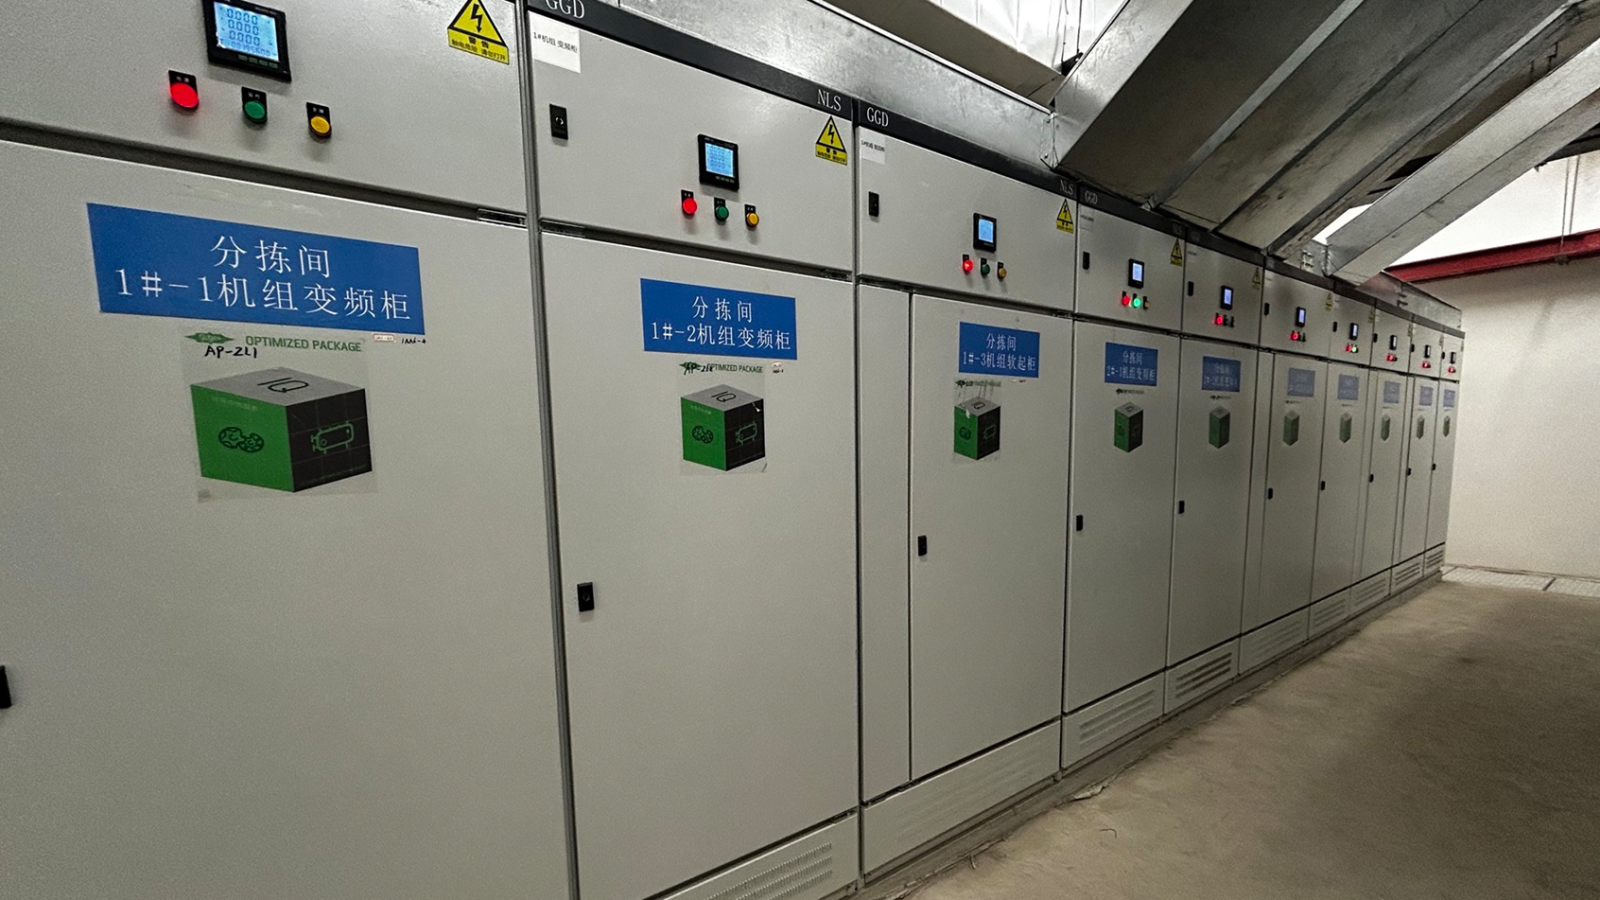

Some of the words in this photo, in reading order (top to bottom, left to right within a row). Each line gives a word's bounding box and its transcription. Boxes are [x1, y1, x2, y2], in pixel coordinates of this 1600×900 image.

[817, 88, 842, 111] NLS
[866, 106, 889, 127] GGD
[210, 235, 330, 278] 分拣间
[115, 268, 411, 320] 1#-1机组变频柜
[692, 295, 752, 323] 分拣间
[245, 335, 309, 350] OPTIMIZED
[312, 341, 361, 352] PACKAGE
[651, 322, 791, 350] 1#-2机组变频柜
[986, 333, 1016, 351] 分拣间
[739, 364, 763, 374] PACKAGE
[963, 351, 1036, 371] 1#-3机组软起柜
